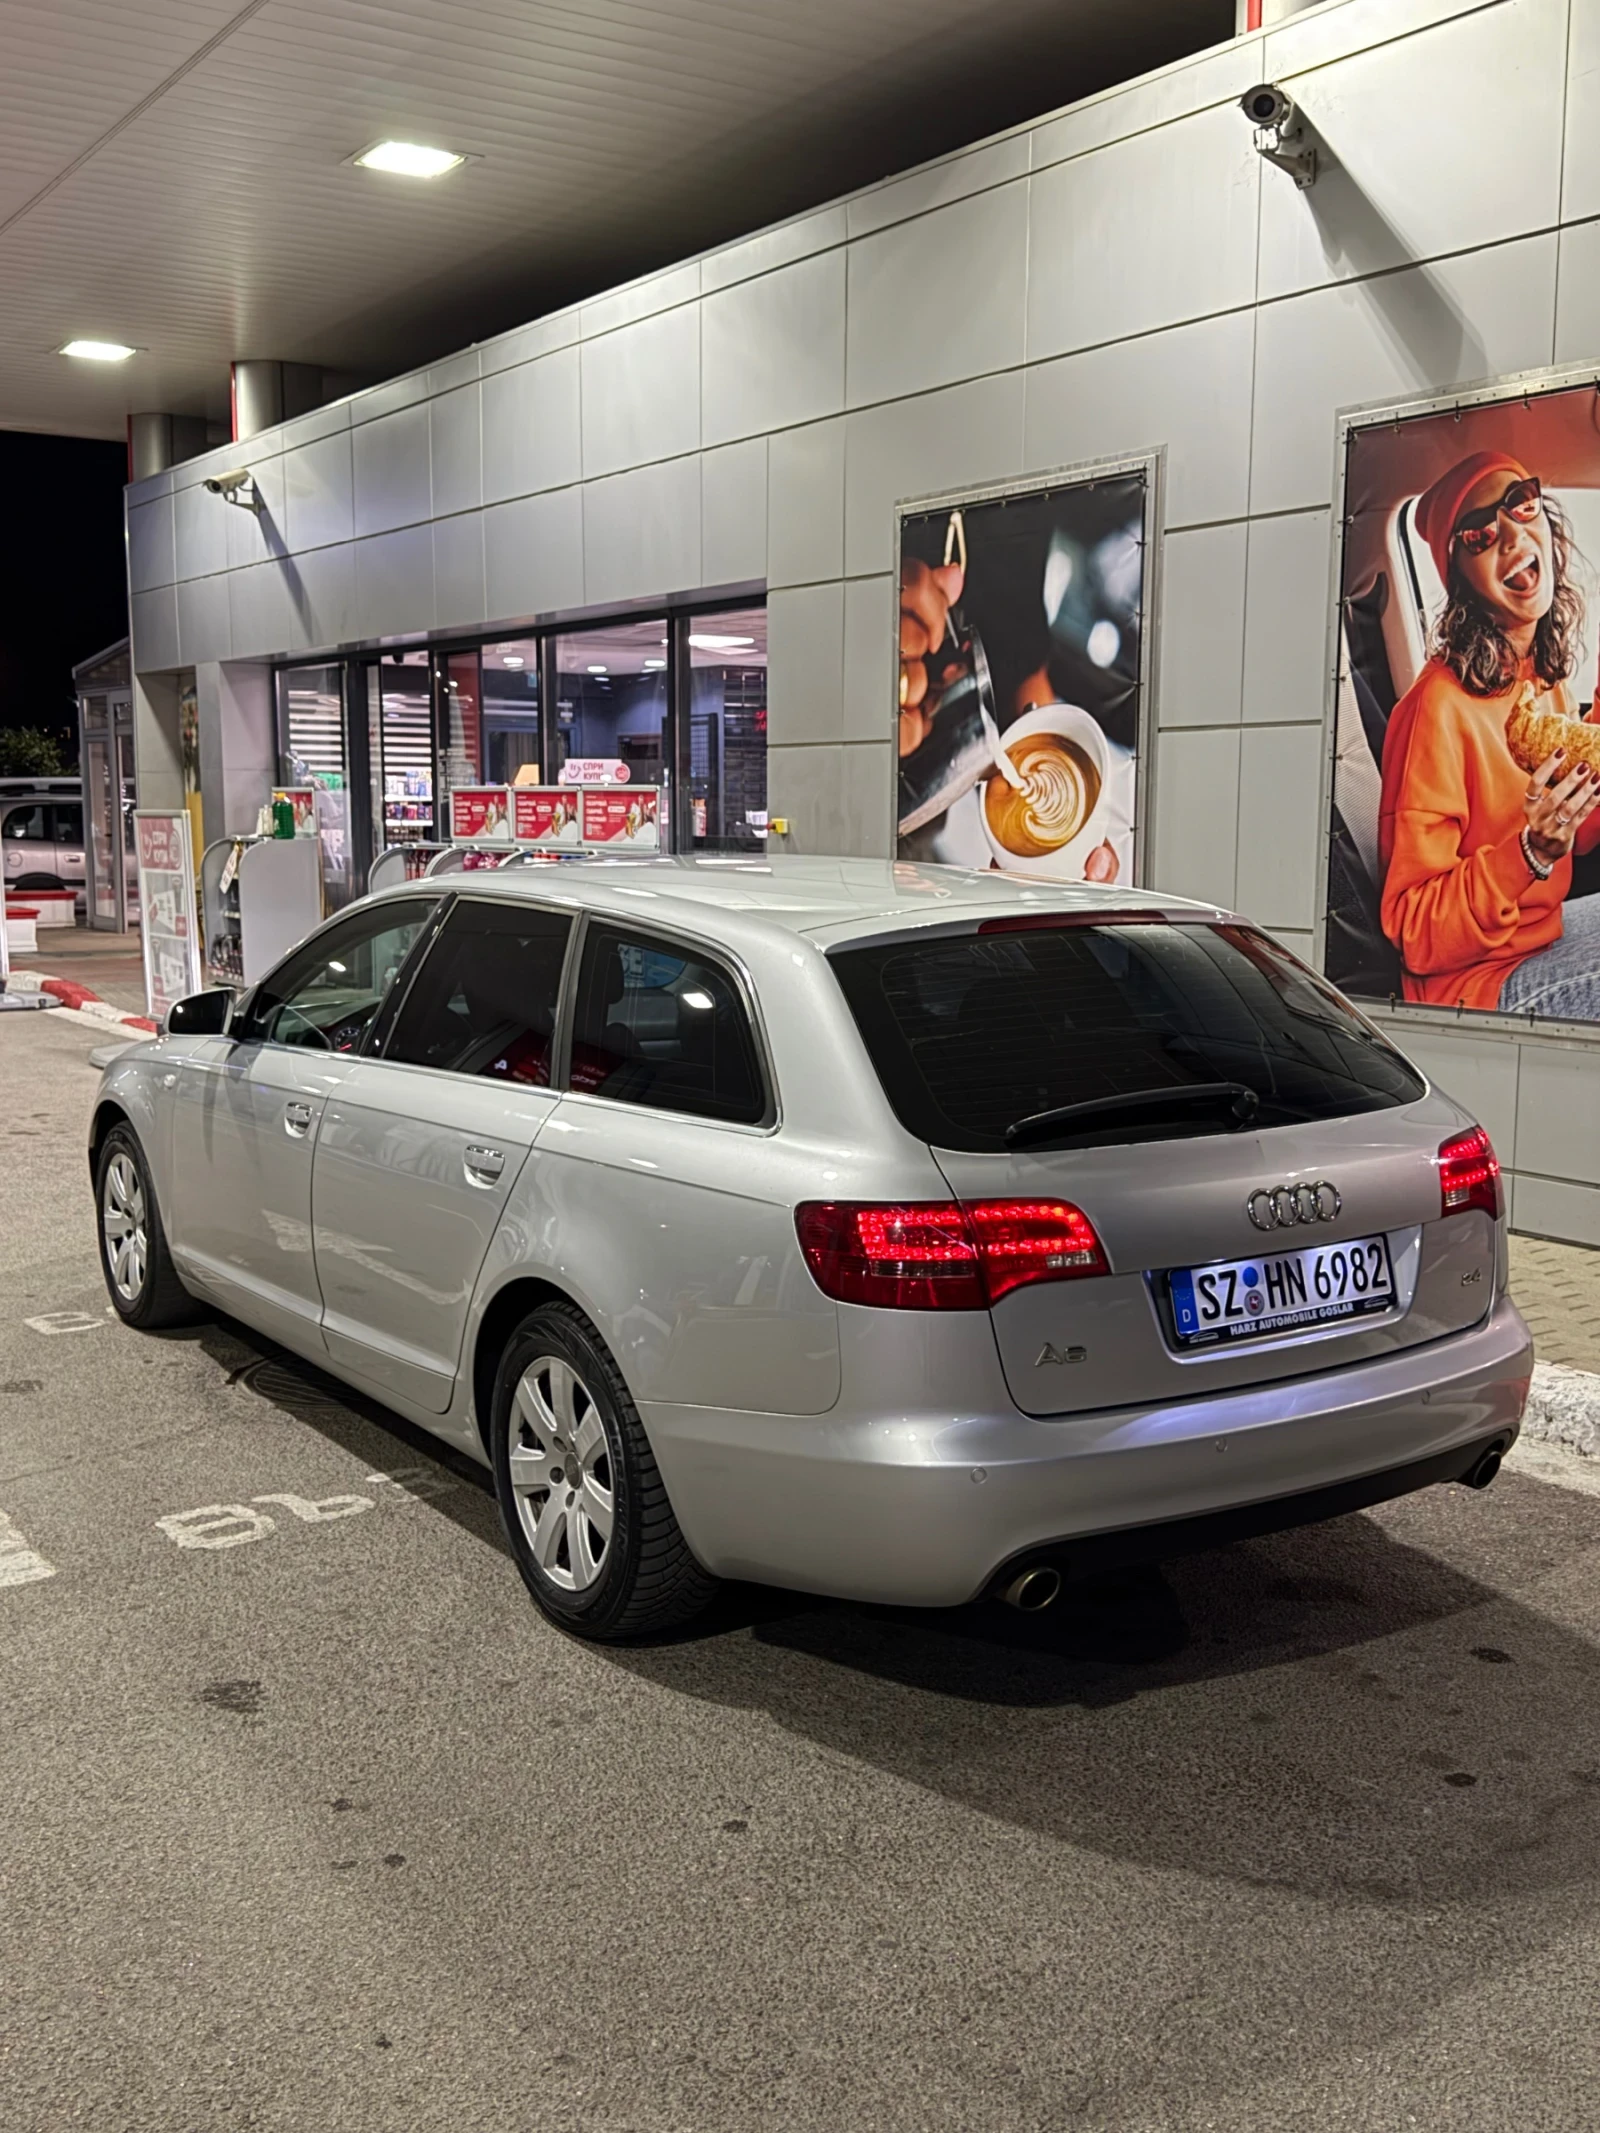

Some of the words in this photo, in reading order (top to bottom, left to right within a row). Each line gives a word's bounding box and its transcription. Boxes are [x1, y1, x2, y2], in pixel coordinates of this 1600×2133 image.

[1198, 1270, 1244, 1320] SZ
[1264, 1257, 1308, 1309] HN
[1314, 1243, 1388, 1299] 6982
[1182, 1309, 1192, 1322] D
[1230, 1322, 1257, 1336] HARZ
[1258, 1310, 1318, 1330] AUTOMOBILE
[1319, 1302, 1355, 1318] GOSLAR
[1034, 1341, 1088, 1367] A6
